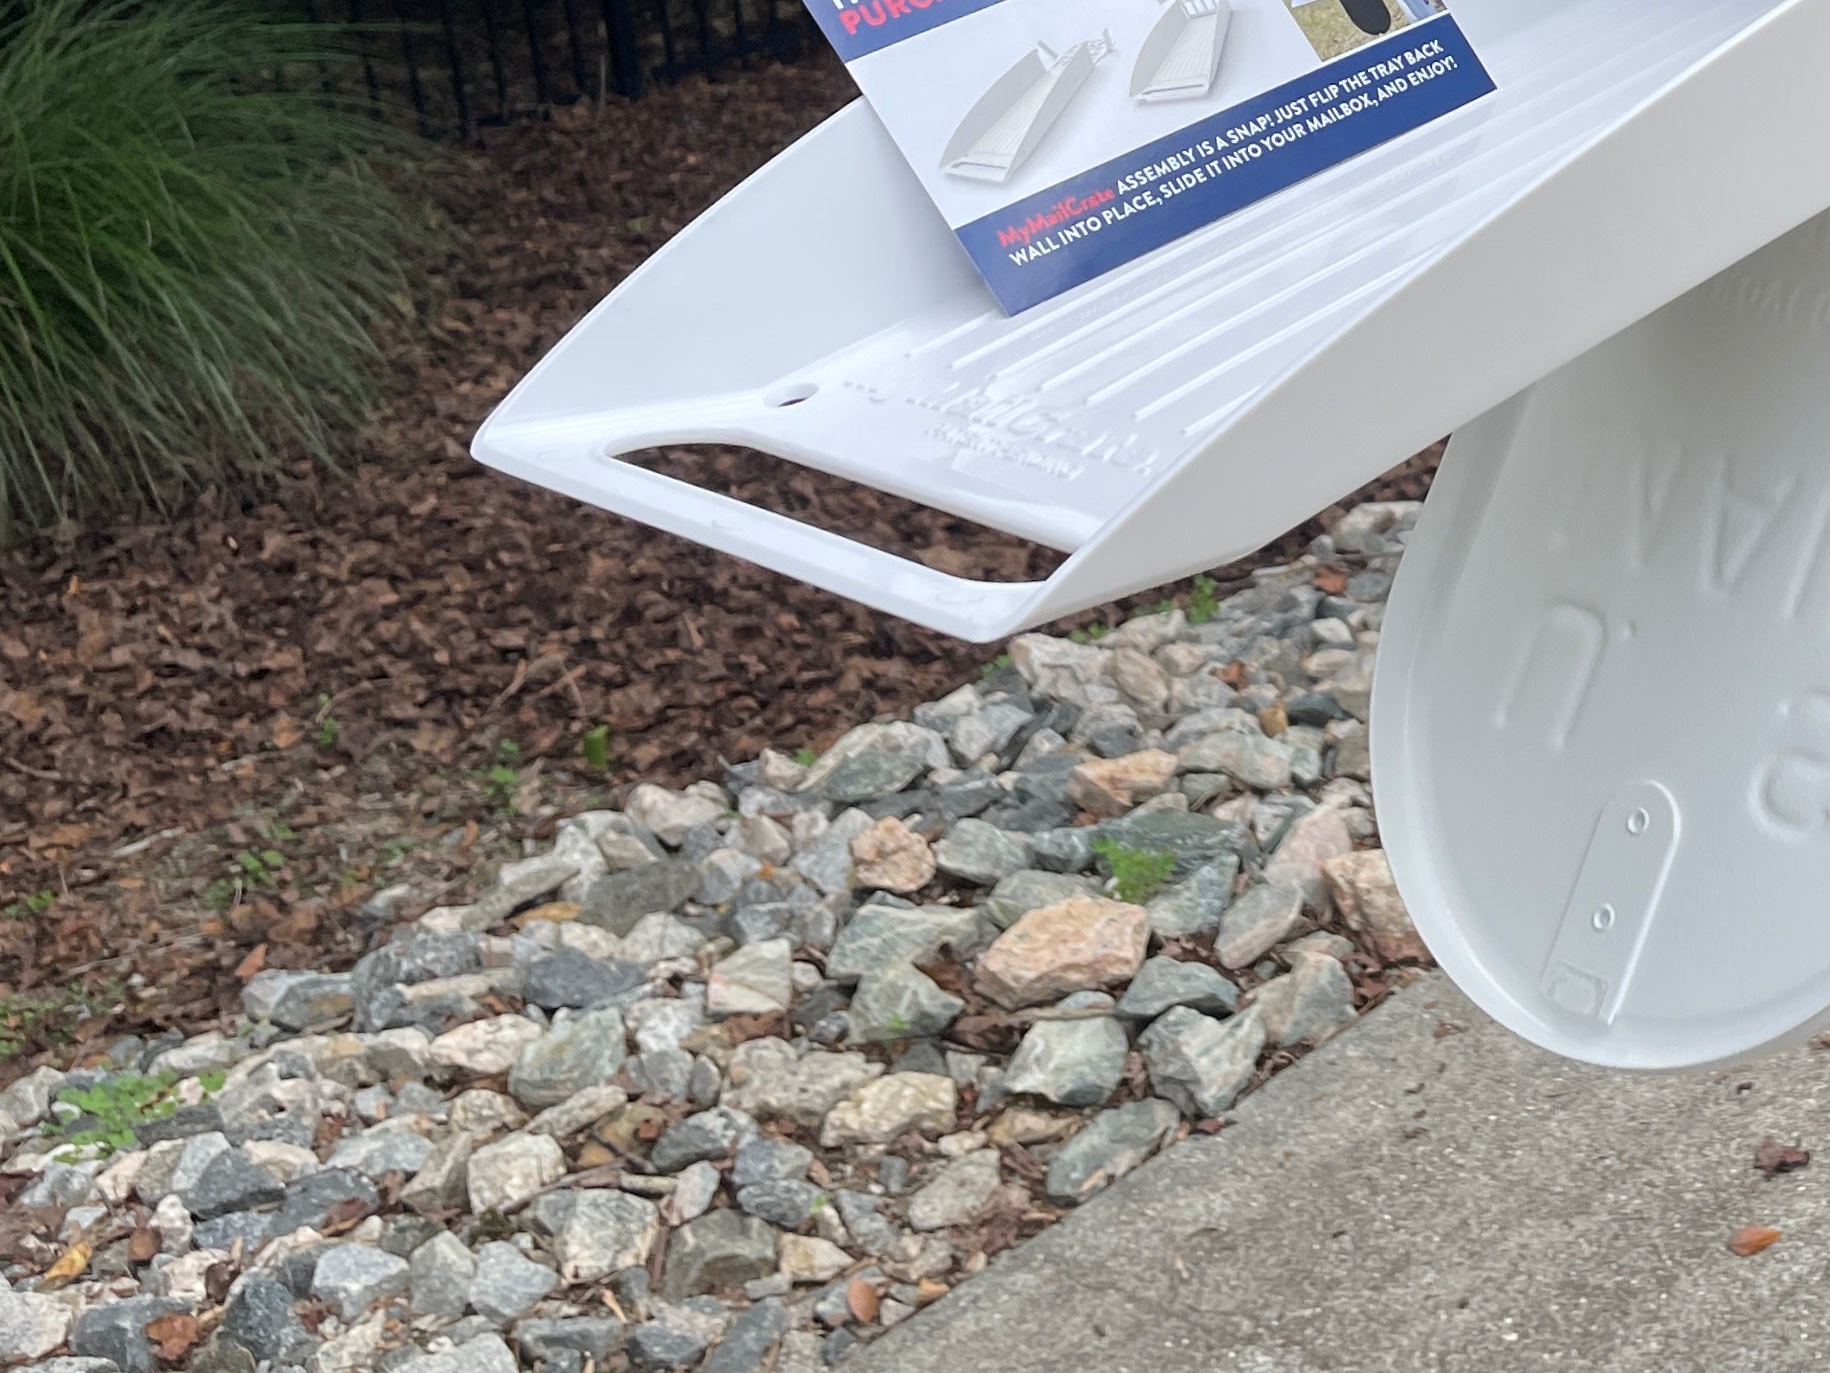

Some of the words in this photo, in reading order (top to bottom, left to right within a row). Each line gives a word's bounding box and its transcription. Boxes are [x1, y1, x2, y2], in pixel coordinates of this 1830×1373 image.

[997, 188, 1115, 248] MyMailCrate
[1117, 147, 1196, 195] ASSEMBLY
[1197, 140, 1215, 158] IS
[1217, 136, 1229, 151] A
[1226, 113, 1275, 144] SNAP!
[1276, 98, 1309, 124] JUST
[1307, 83, 1340, 108] FLIP
[1338, 71, 1372, 94] THE
[1367, 56, 1405, 81] TRAY
[1404, 39, 1444, 66] BACK
[1008, 236, 1061, 266] WALL
[1057, 217, 1103, 246] INTO
[1101, 191, 1163, 226] PLACE,
[1159, 167, 1208, 199] SLIDE
[1205, 160, 1221, 178] IT
[1222, 143, 1262, 171] INTO
[1260, 124, 1310, 152] YOUR
[1306, 92, 1380, 133] MAILBOX,
[1377, 78, 1409, 103] AND
[1407, 55, 1458, 87] ENJOY!
